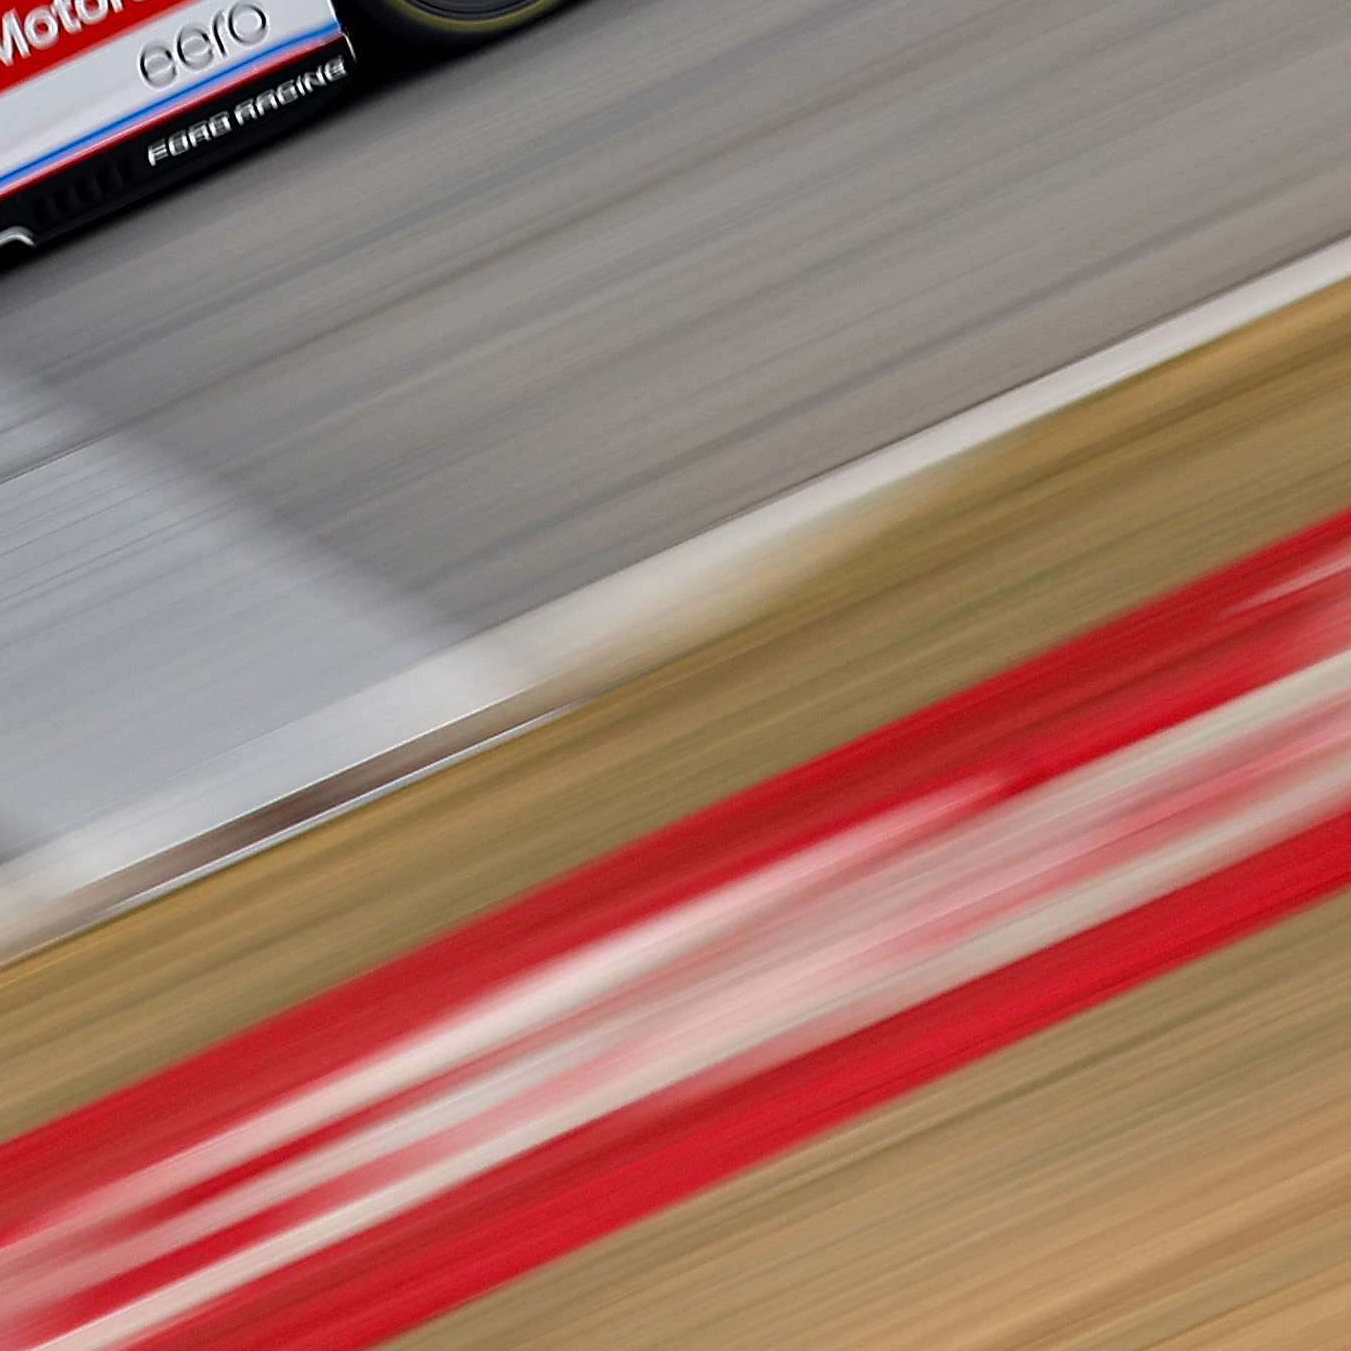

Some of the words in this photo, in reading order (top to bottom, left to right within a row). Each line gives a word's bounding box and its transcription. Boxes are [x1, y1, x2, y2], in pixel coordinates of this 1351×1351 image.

[138, 0, 270, 87] eero
[148, 109, 233, 166] FORD
[233, 54, 348, 127] RACING
